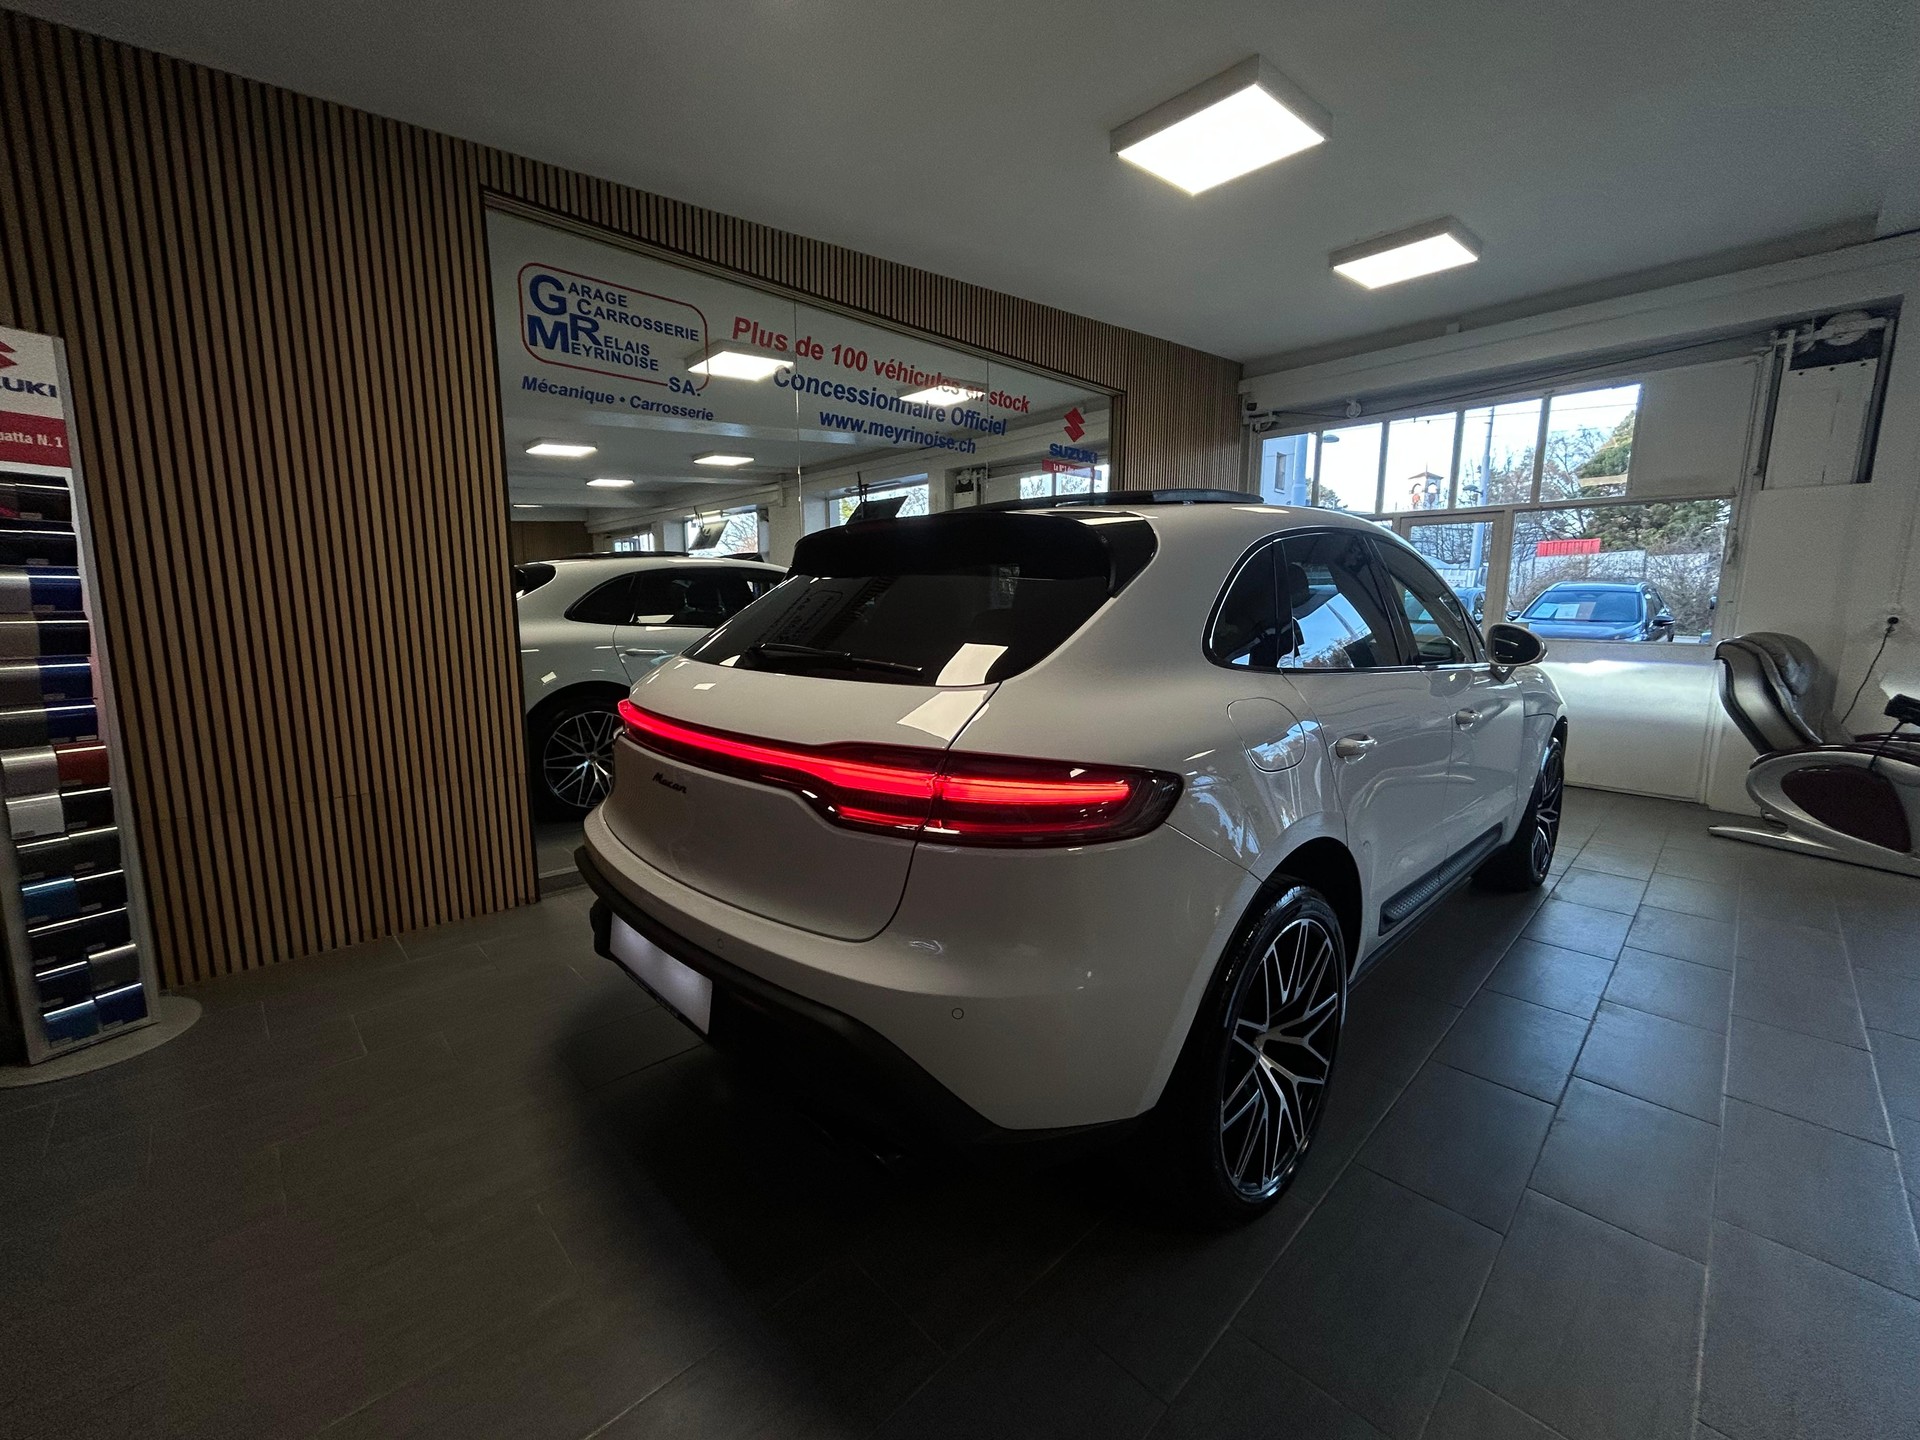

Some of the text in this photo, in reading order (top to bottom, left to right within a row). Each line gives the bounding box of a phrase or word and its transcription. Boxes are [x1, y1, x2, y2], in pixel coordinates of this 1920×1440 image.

[529, 274, 628, 316] GARAGE
[570, 312, 651, 356] RELAIS
[577, 298, 700, 342] CARROSSERIE
[527, 314, 660, 372] MEYRINOISE
[732, 316, 788, 352] Plus
[795, 335, 825, 360] de
[831, 344, 868, 373] 100
[873, 357, 961, 396] véhicules
[989, 388, 1030, 414] stock
[0, 377, 57, 398] UKI
[522, 375, 714, 421] Mécanique Carrosserie
[773, 364, 1007, 436] Concessionnaire Officiel
[819, 410, 977, 454] www.meyrinoise.ch
[1049, 443, 1098, 464] SUZUKI
[652, 772, 688, 794] Macan
